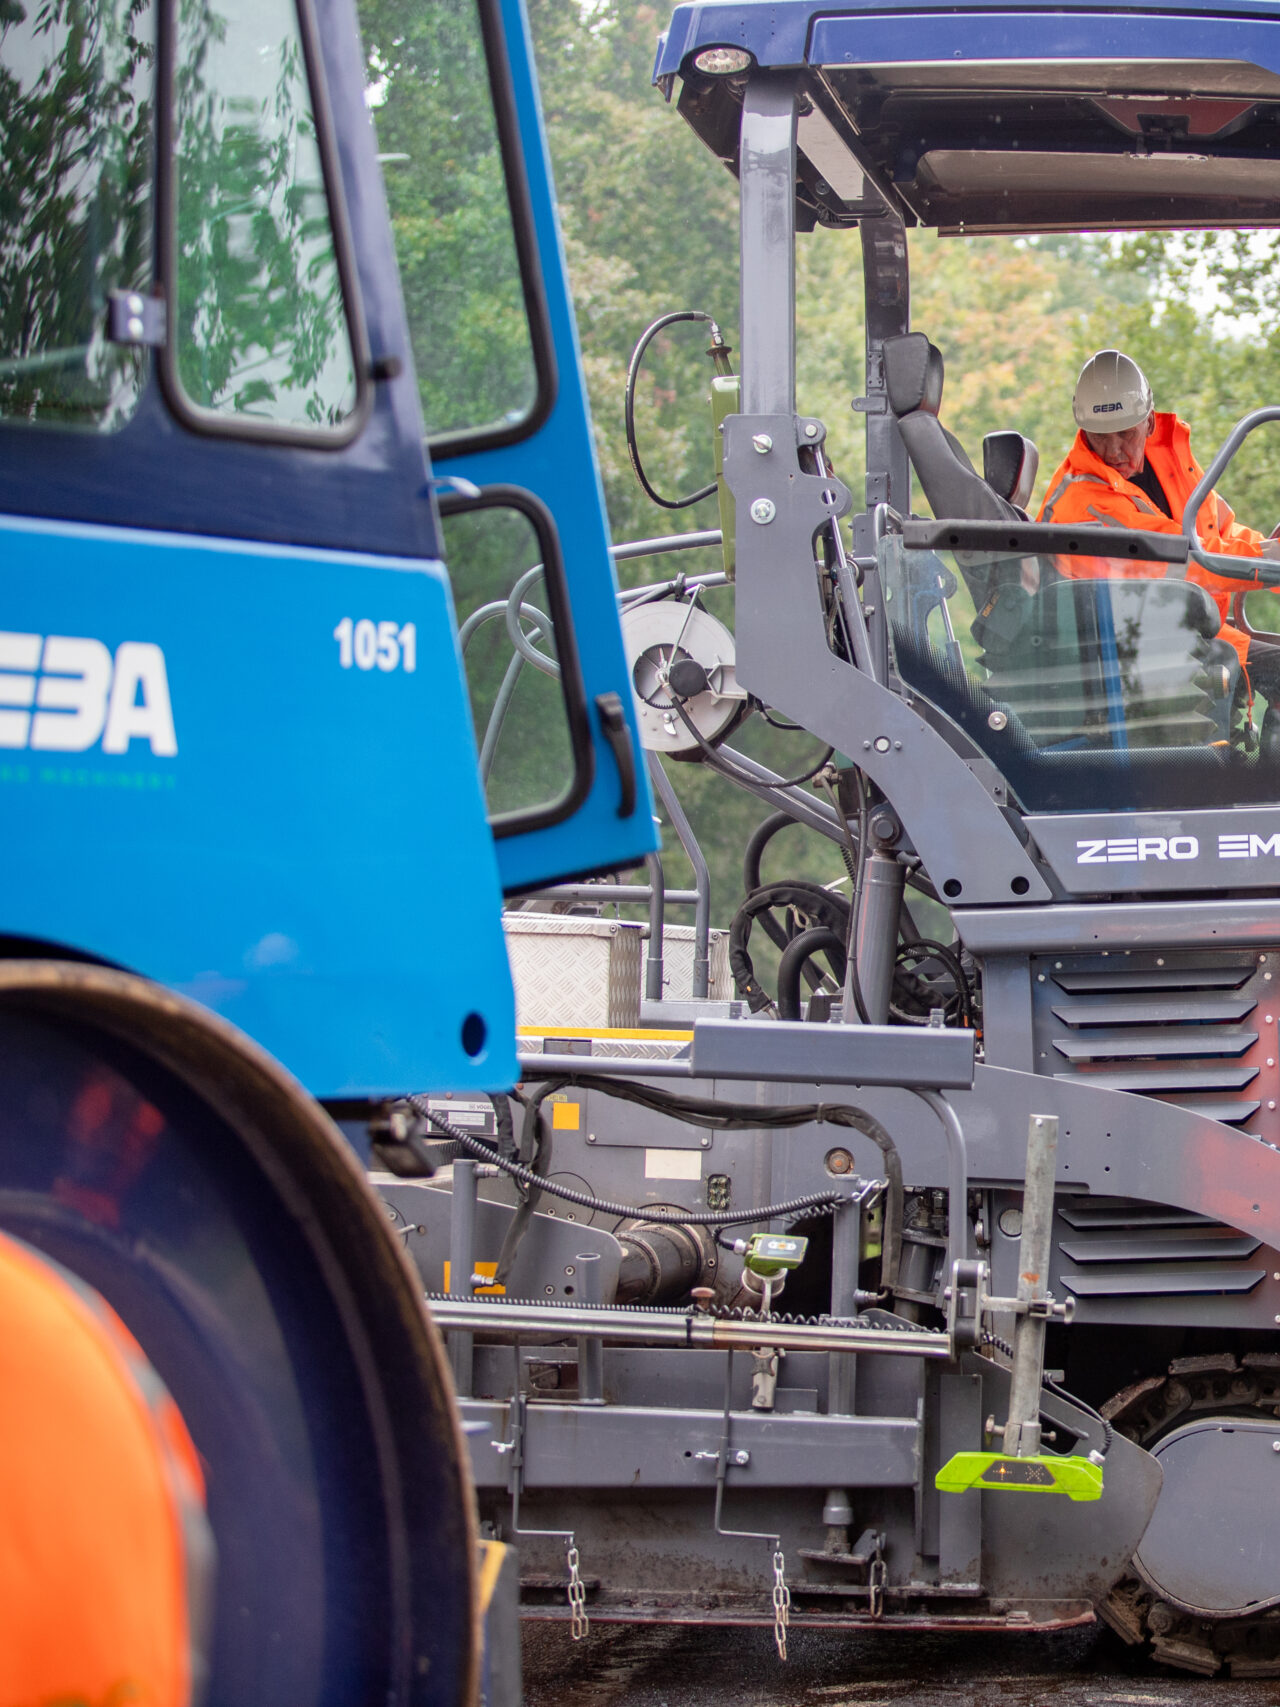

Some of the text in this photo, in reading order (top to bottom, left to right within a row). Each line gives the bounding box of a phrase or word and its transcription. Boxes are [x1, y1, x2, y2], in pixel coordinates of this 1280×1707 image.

[1092, 402, 1123, 414] GEBA
[333, 616, 417, 674] 1051
[0, 630, 178, 757] EBA
[1076, 835, 1199, 864] ZERO
